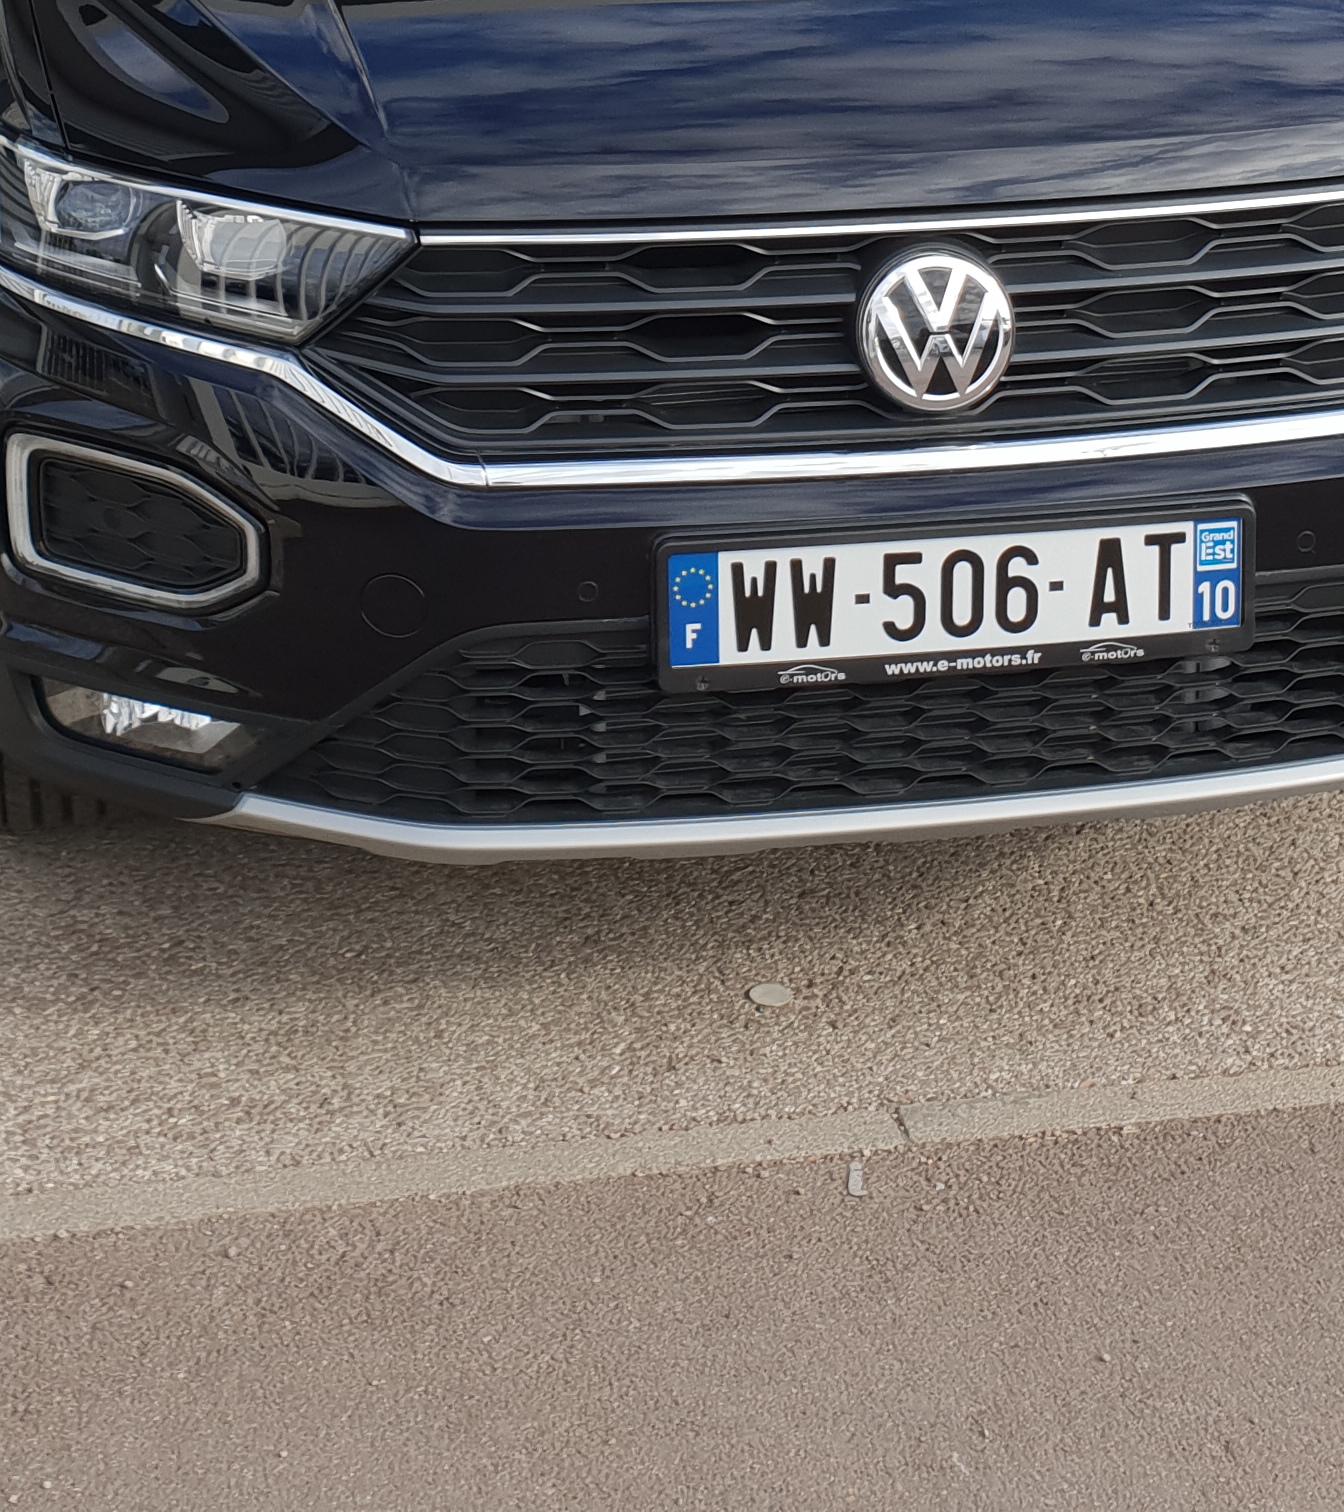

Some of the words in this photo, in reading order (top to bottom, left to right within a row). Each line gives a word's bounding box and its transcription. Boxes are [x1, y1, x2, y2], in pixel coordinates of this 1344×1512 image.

[1201, 530, 1234, 542] Grand
[1201, 541, 1234, 561] Est
[1198, 580, 1236, 621] 10
[685, 623, 702, 649] F
[885, 650, 1042, 676] www.e-motors.fr
